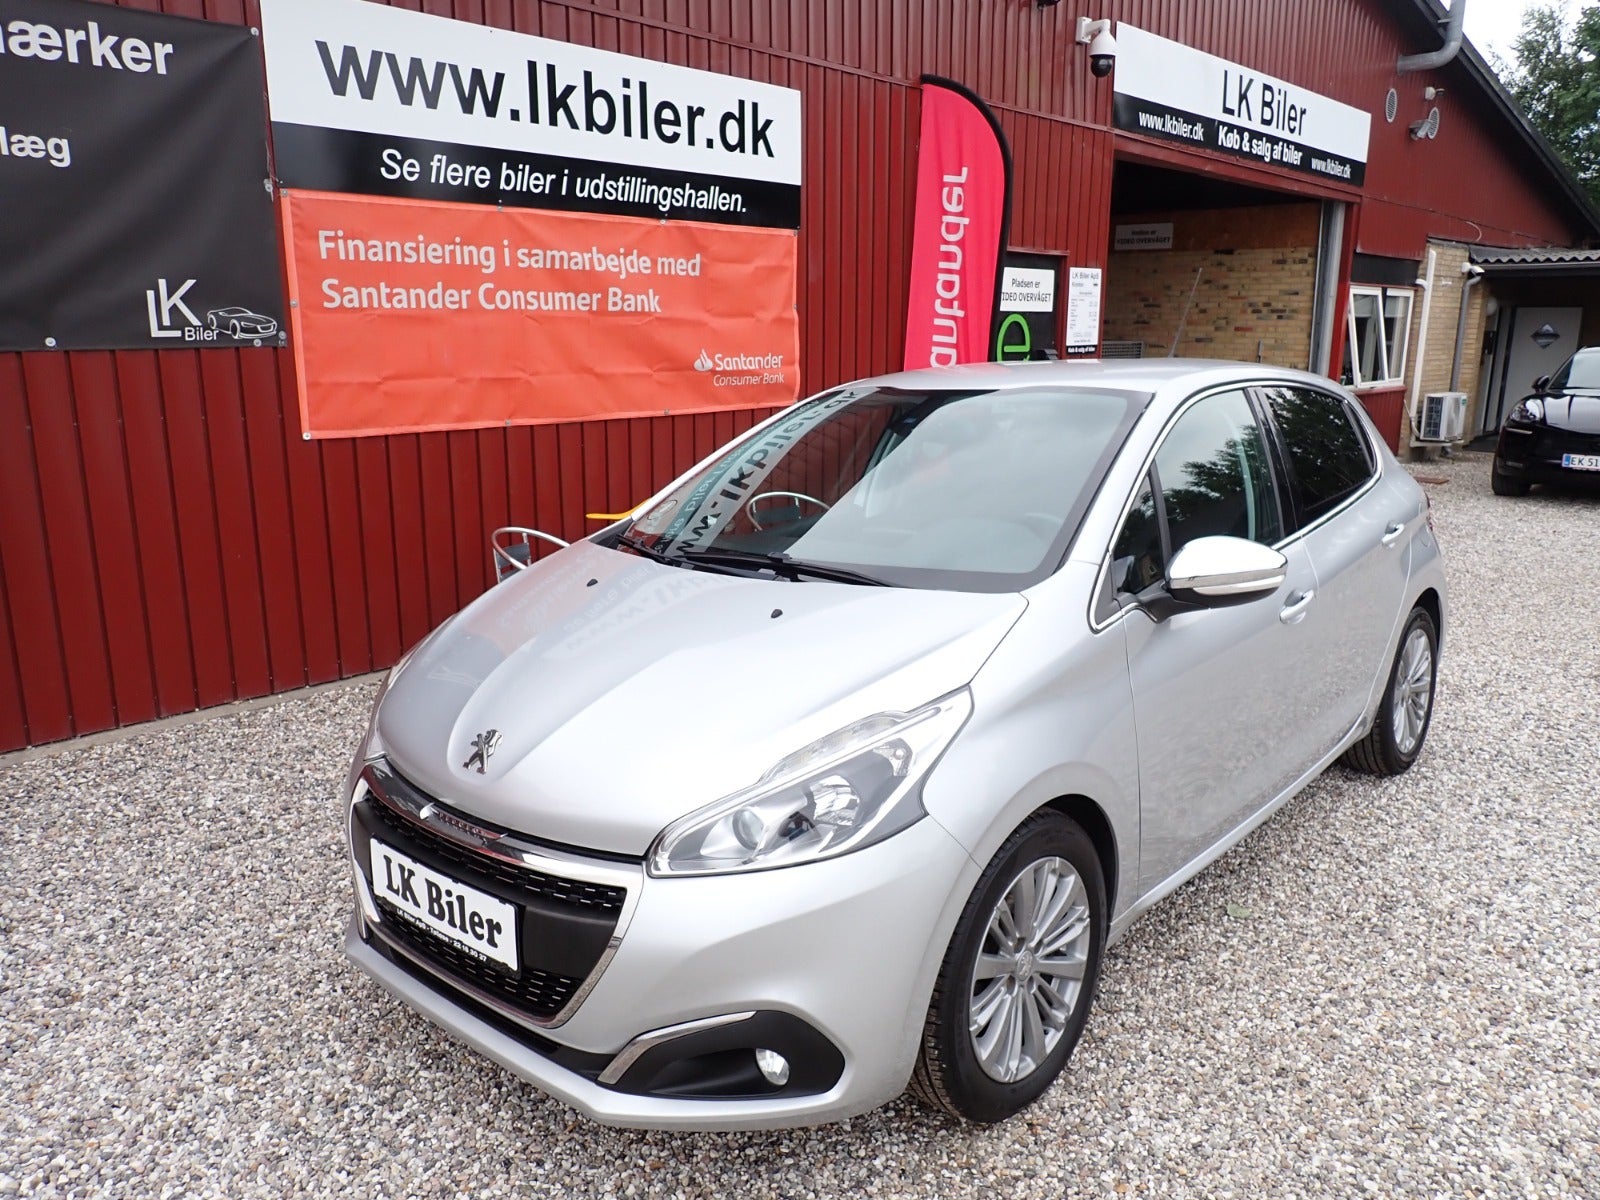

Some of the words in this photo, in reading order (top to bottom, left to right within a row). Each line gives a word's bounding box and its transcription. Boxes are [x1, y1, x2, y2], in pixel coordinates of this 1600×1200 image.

[0, 20, 173, 75] ærker
[315, 40, 774, 157] www.lkbiler.dk
[1222, 69, 1254, 122] LK
[1260, 83, 1306, 136] Biler
[1138, 111, 1204, 142] www.lkbiler.dk
[1218, 125, 1240, 150] Køb
[1242, 131, 1251, 152] &
[1251, 136, 1271, 163] salg
[1273, 140, 1283, 160] af
[1283, 143, 1303, 166] biler
[380, 149, 420, 181] Se
[430, 154, 491, 188] flere
[500, 162, 553, 195] biler
[562, 169, 569, 195] i
[575, 175, 747, 213] udstillingshallen.
[318, 230, 496, 274] Finansiering
[502, 240, 510, 268] i
[517, 245, 652, 280] samarbejde
[657, 253, 701, 277] med
[321, 279, 471, 310] Santander
[478, 282, 602, 312] Consumer
[608, 286, 662, 313] Bank
[1001, 291, 1017, 302] IDEO
[1018, 291, 1052, 302] OVERVÅGET
[1011, 278, 1034, 288] Pladsen
[146, 278, 202, 338] LK
[184, 326, 219, 341] Biler
[713, 374, 762, 387] Consumer
[763, 372, 785, 385] Bank
[714, 352, 784, 371] Santander
[1571, 456, 1584, 466] EK
[383, 854, 421, 909] LK
[425, 877, 503, 949] Biler
